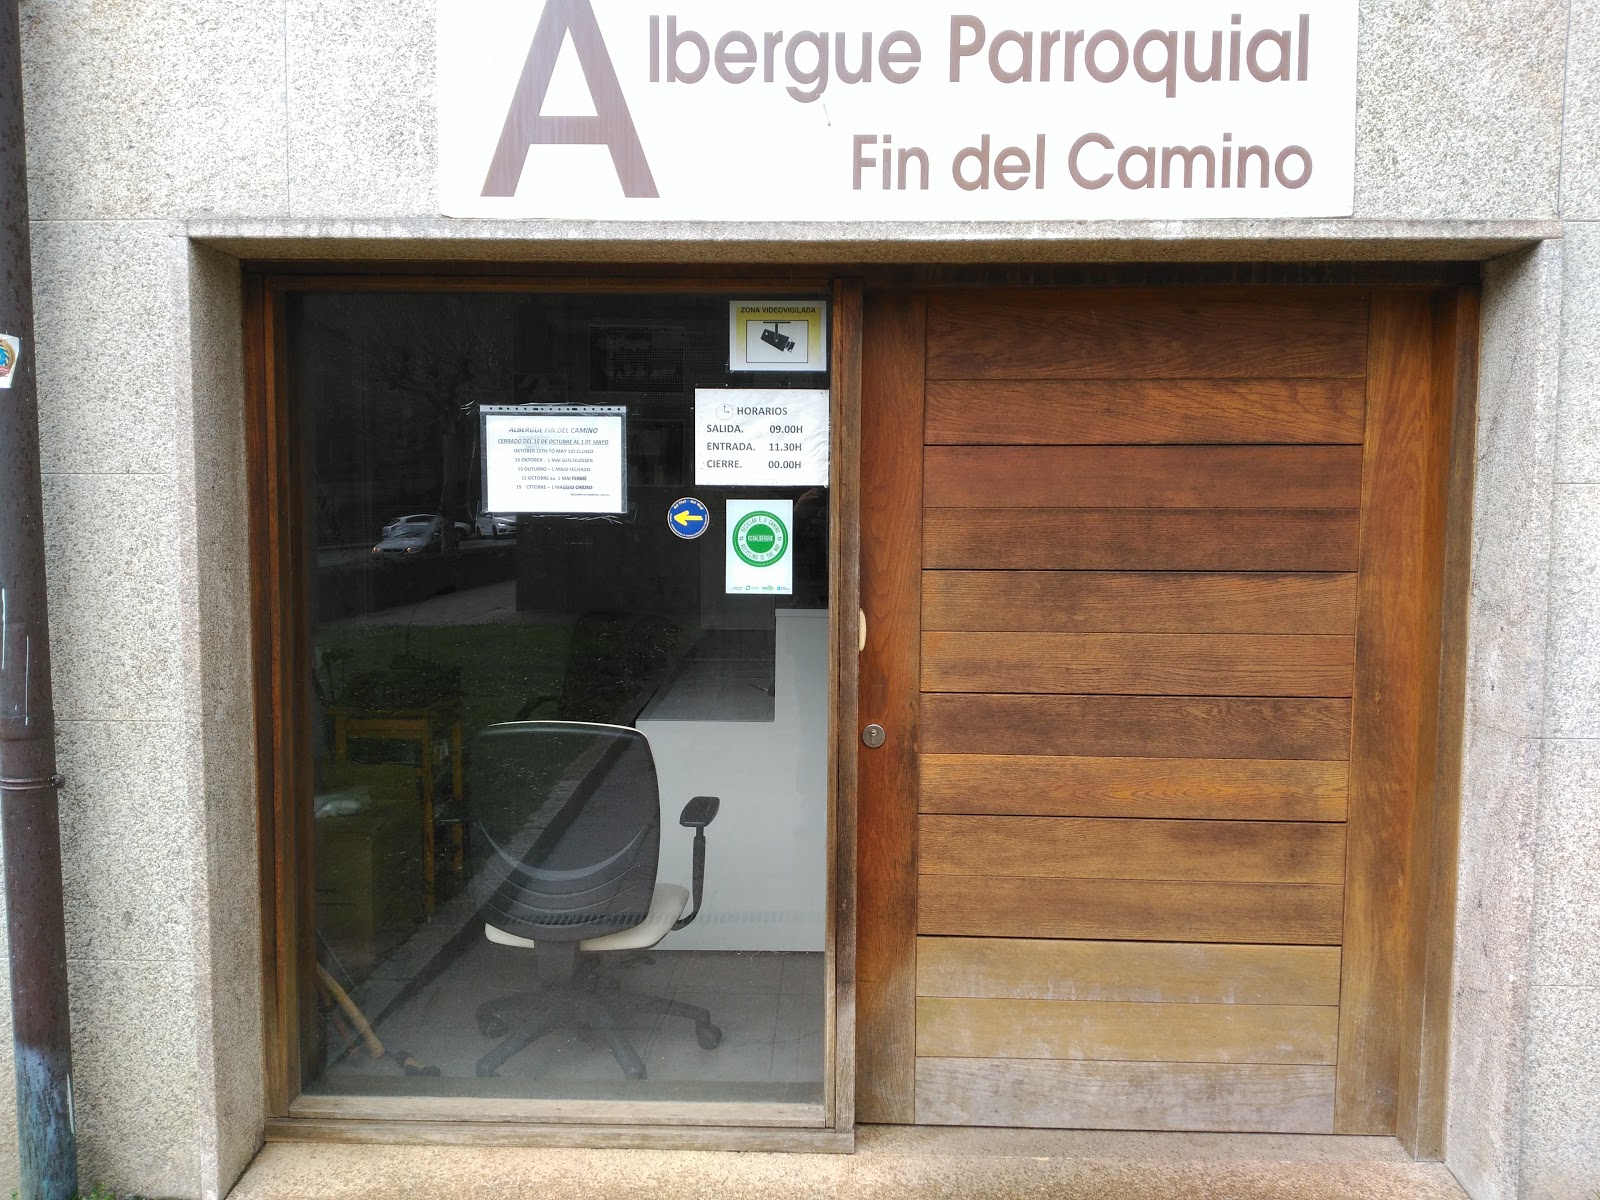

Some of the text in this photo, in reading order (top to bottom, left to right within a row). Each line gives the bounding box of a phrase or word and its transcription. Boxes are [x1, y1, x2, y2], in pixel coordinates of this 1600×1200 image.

[949, 14, 1310, 98] Parroquial
[852, 132, 1313, 191] Fin del Camino
[737, 407, 788, 415] HORARIOS
[706, 424, 803, 433] SALIDA. 09.00H
[706, 442, 802, 451] ENTRADA. 11.30H
[706, 459, 801, 469] CIERRE. 00.00H
[741, 543, 759, 560] RECYCLING
